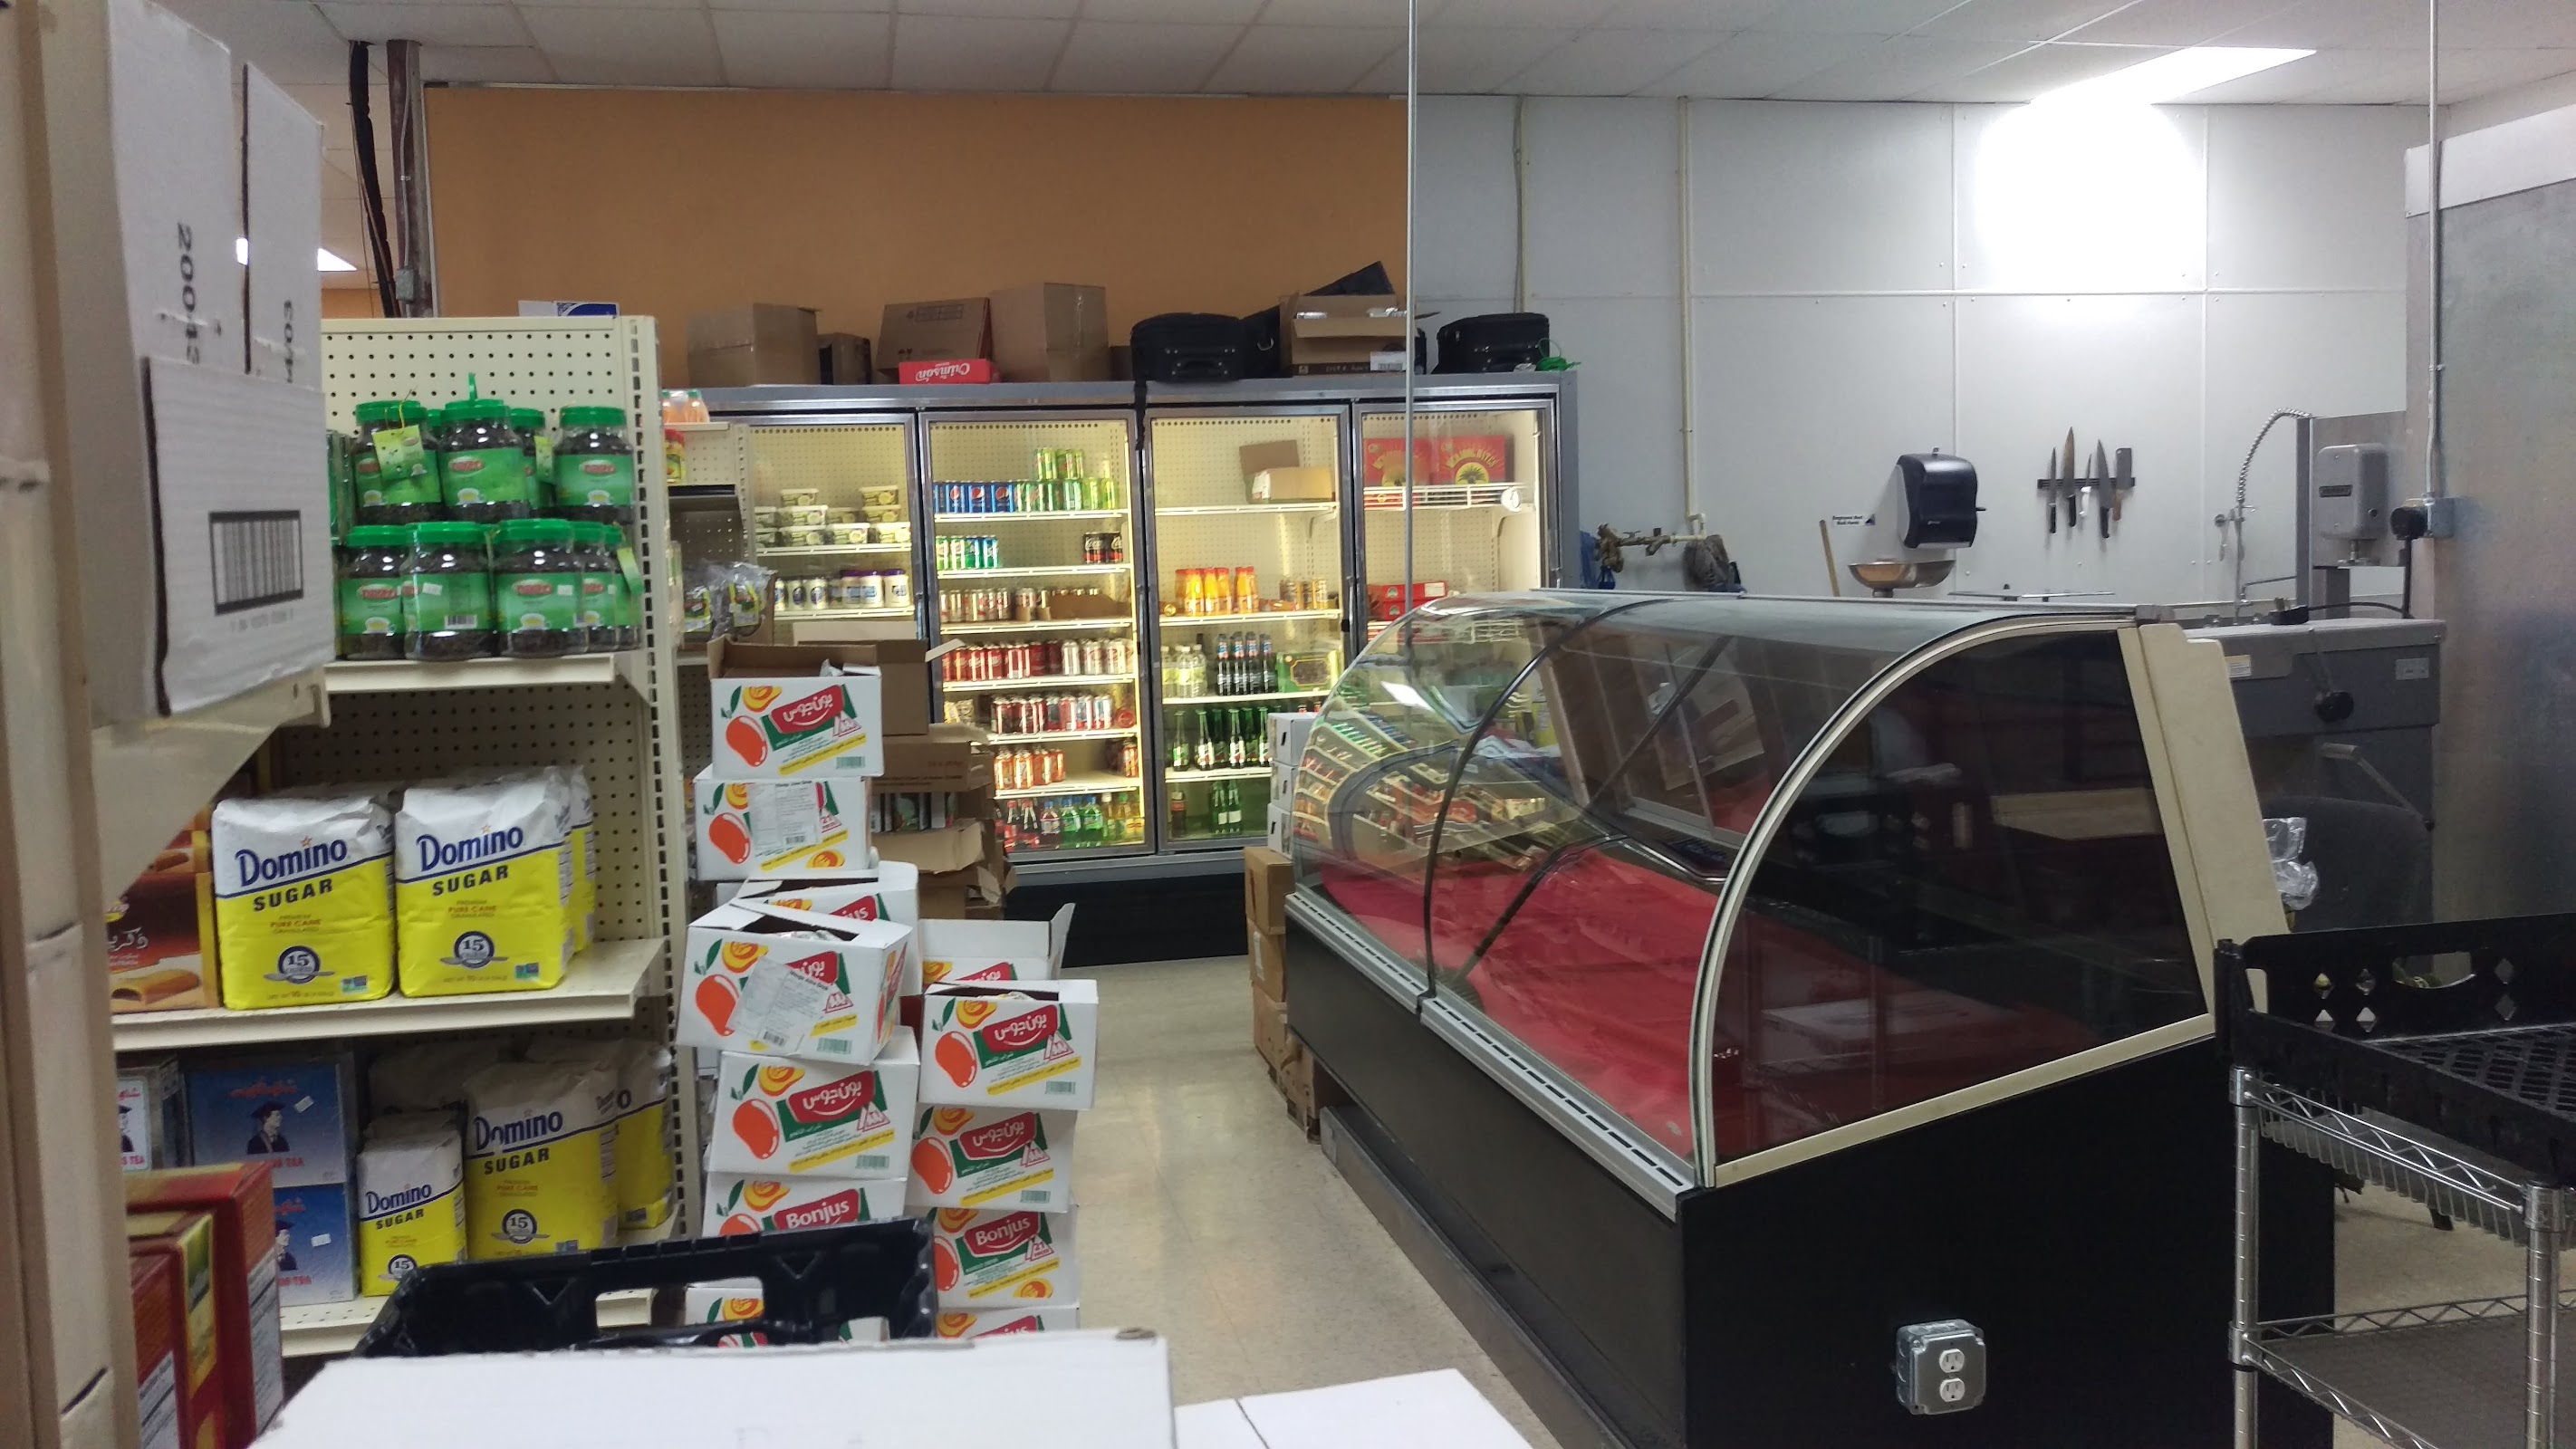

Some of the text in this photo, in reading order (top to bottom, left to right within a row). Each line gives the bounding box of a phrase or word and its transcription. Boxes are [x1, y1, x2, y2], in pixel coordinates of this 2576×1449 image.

[915, 363, 971, 382] Crimson
[235, 839, 348, 888] Domino
[416, 826, 524, 872] Domino
[253, 878, 333, 912] SUGAR
[431, 864, 509, 897] SUGAR
[462, 939, 485, 951] 15
[287, 954, 311, 966] 15
[474, 1110, 563, 1151] Domino
[484, 1147, 550, 1175] SUGAR
[365, 1184, 432, 1214] Domino
[375, 1208, 424, 1230] SUGAR
[510, 1216, 528, 1229] 15
[785, 1199, 850, 1230] Bonjus
[975, 1217, 1031, 1246] Bonjus
[394, 1260, 409, 1270] 15
